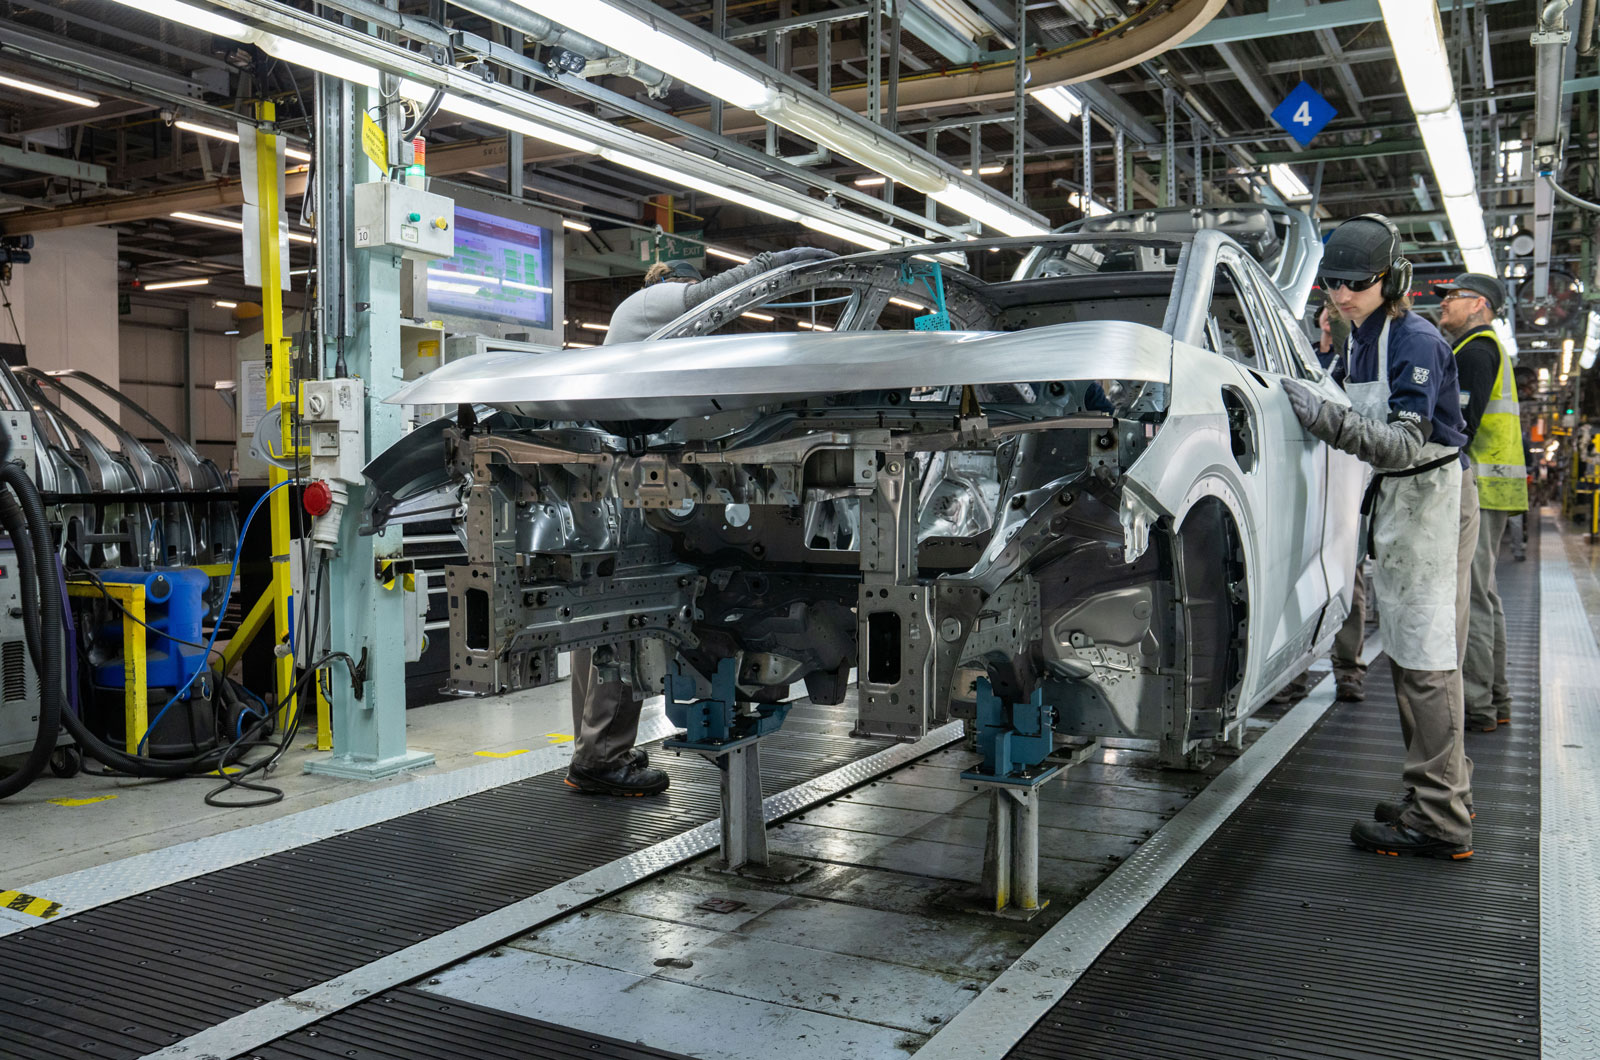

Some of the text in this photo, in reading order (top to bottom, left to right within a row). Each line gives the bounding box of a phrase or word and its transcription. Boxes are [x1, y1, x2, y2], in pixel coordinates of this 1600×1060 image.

[1293, 101, 1312, 126] 4
[359, 231, 368, 241] 10
[683, 246, 701, 256] EXIT
[1398, 410, 1421, 422] MAPA
